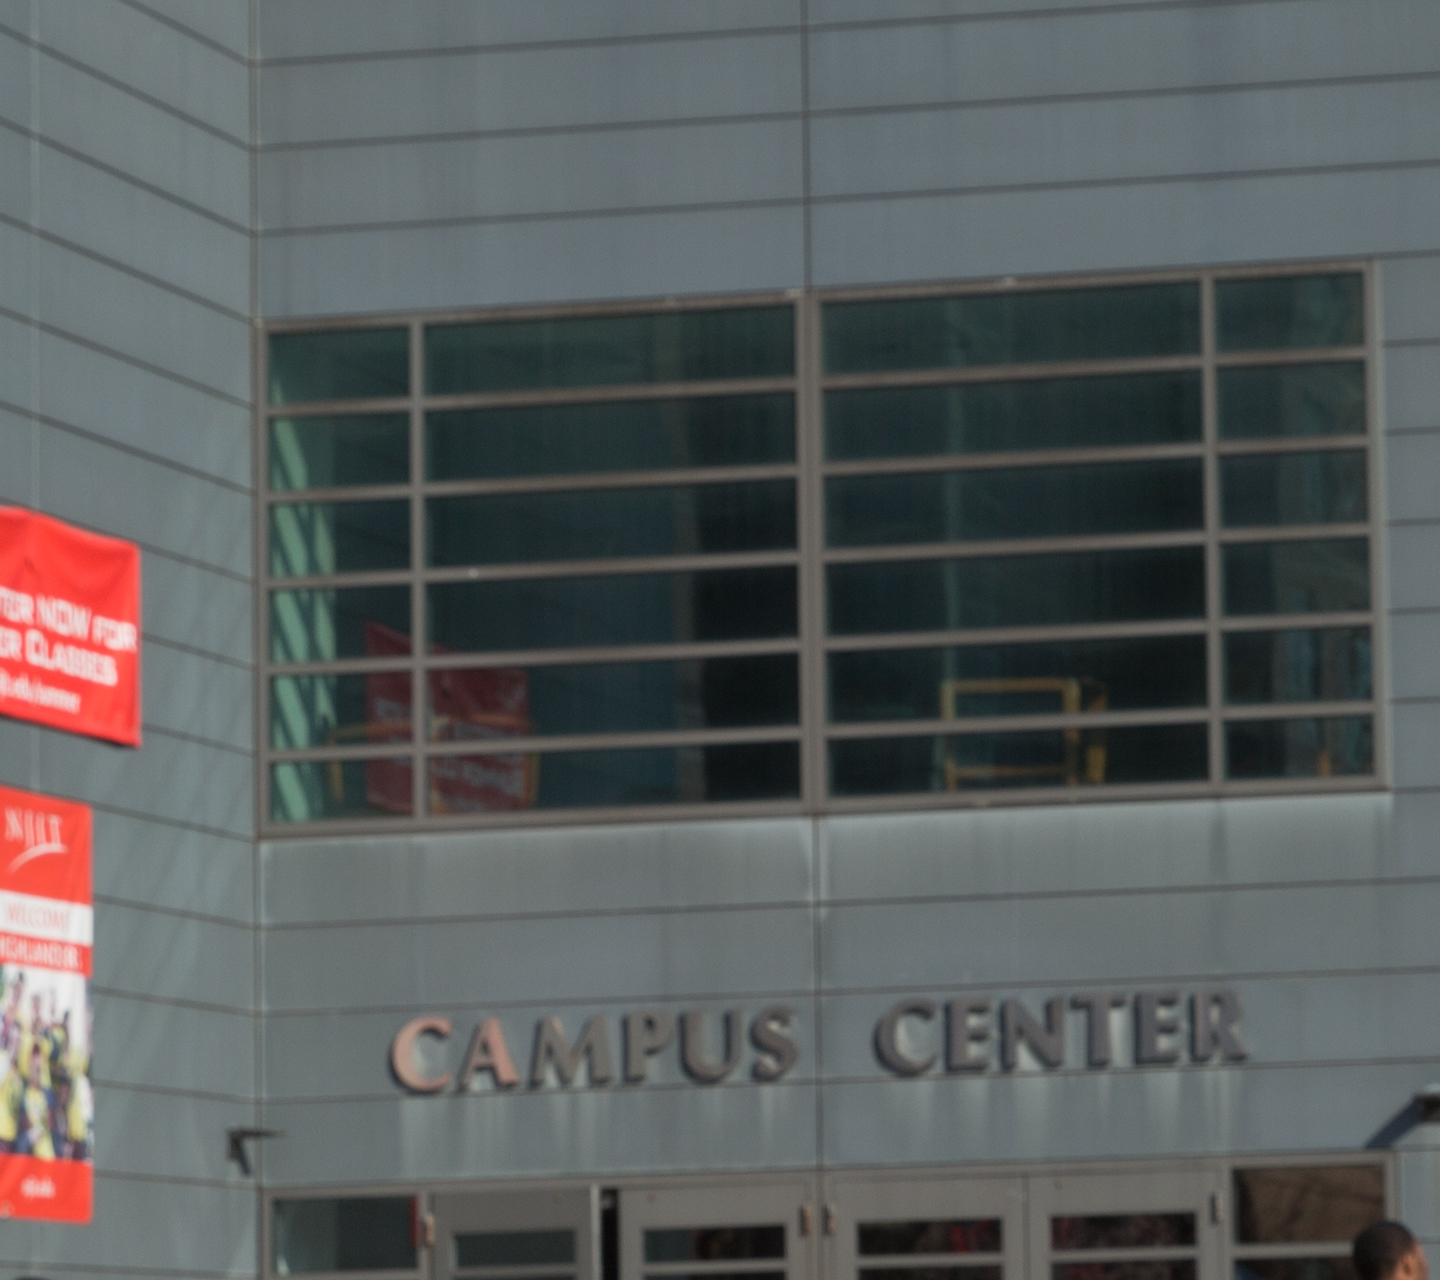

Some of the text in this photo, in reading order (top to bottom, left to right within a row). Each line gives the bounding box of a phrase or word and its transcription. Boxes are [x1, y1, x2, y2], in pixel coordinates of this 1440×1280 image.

[35, 593, 92, 641] NOW
[92, 615, 138, 653] FOR
[25, 628, 118, 687] CLASSES
[5, 808, 62, 847] NJIT
[388, 988, 1250, 1094] CAMPUS CENTER
